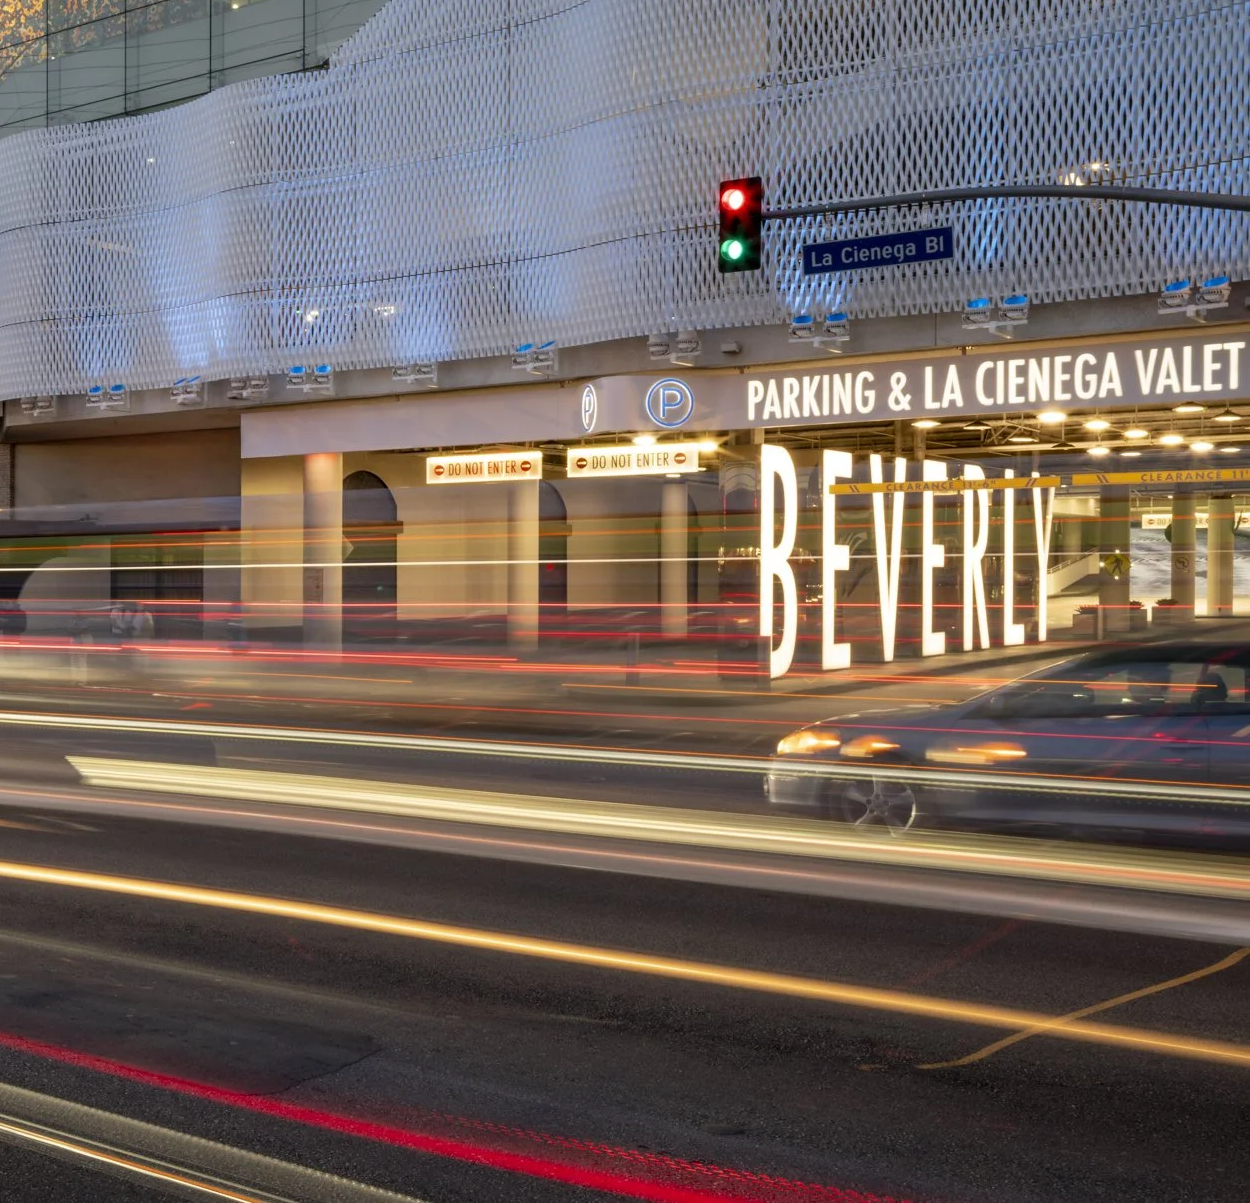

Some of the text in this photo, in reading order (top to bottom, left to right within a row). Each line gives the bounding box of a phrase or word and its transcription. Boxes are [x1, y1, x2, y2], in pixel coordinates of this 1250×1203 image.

[811, 236, 944, 268] La Cienega Bl
[748, 341, 1246, 421] PARKING & LA CIENEGA VALET
[448, 460, 517, 476] DO NOT ENTER
[592, 452, 669, 469] DO NOT ENTER
[1141, 470, 1223, 482] CLEARANCE
[886, 482, 955, 492] CLEARANCE
[759, 443, 1056, 679] BEVERLY
